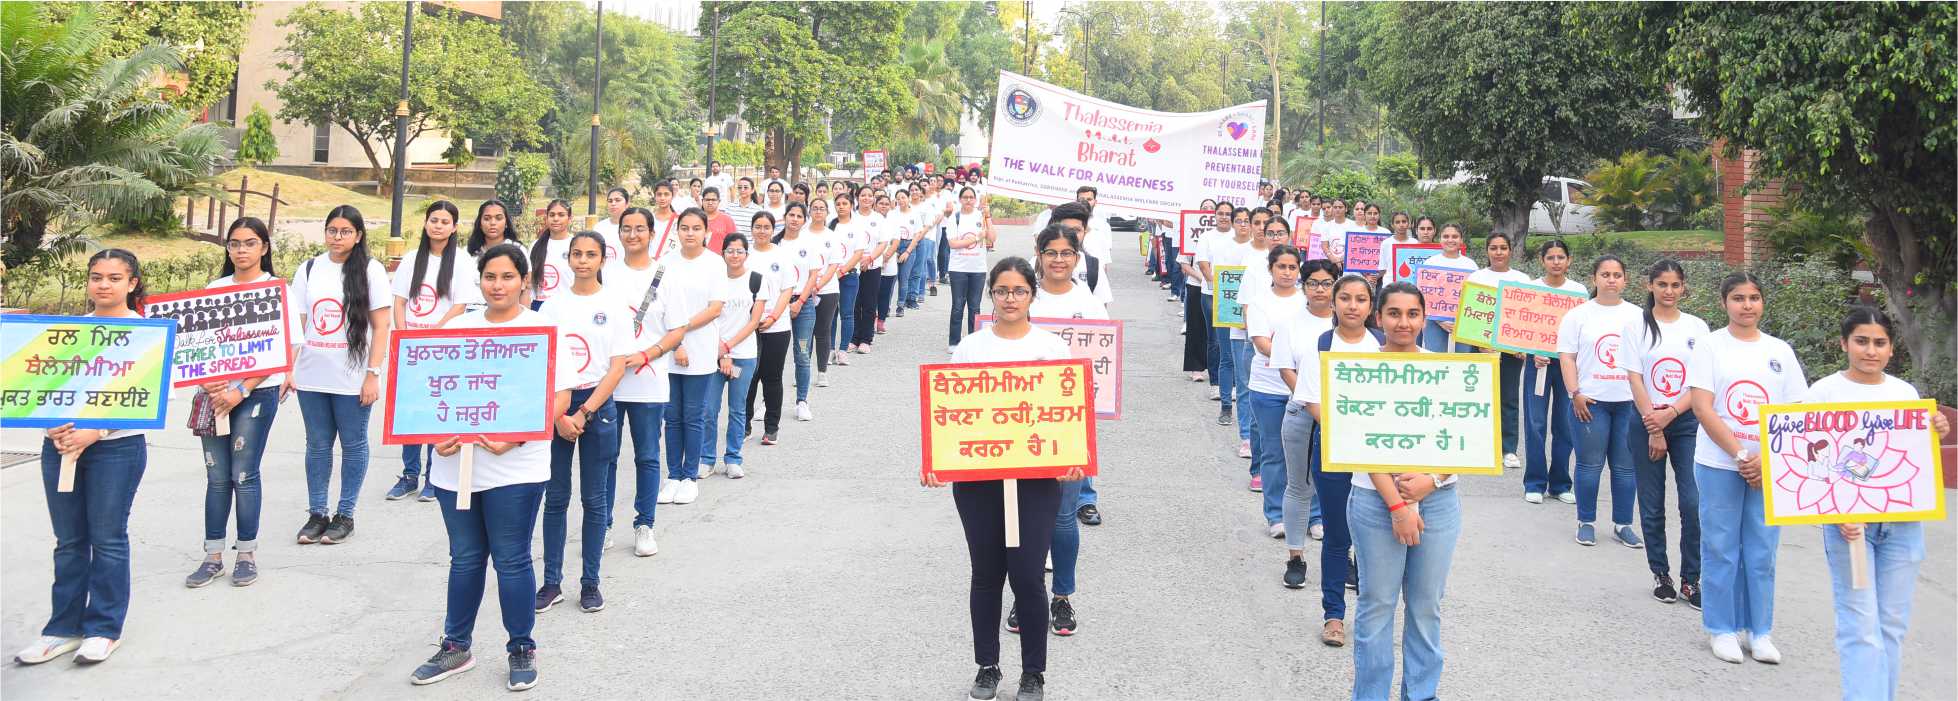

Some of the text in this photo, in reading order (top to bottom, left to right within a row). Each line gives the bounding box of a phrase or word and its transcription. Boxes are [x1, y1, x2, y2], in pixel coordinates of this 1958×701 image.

[1064, 101, 1163, 133] Thalassemia
[1077, 141, 1137, 167] Bharat
[1203, 144, 1257, 158] THALASSEMIA
[1003, 156, 1174, 192] THE WALK FOR AWARENESS
[1205, 161, 1261, 175] PREVENTABLE
[1203, 177, 1217, 189] GET
[1199, 215, 1217, 227] GE
[47, 325, 132, 347] ਰਲ ਮਿਲ
[174, 337, 274, 365] ETHER TO LIMIT
[178, 355, 257, 378] THE SPREAD
[1462, 363, 1480, 393] ਨੂੰ
[1059, 366, 1077, 397] ਨੂੰ
[36, 390, 77, 407] ਭਾਰਤ
[85, 386, 151, 408] ਬਣਾਈਏ
[436, 400, 450, 423] ਹੈ
[1804, 411, 1859, 433] BLOOD
[1894, 408, 1928, 431] LIFE
[959, 439, 1014, 458] ਕਰਨਾ
[1364, 432, 1426, 450] ਕਰਨਾ
